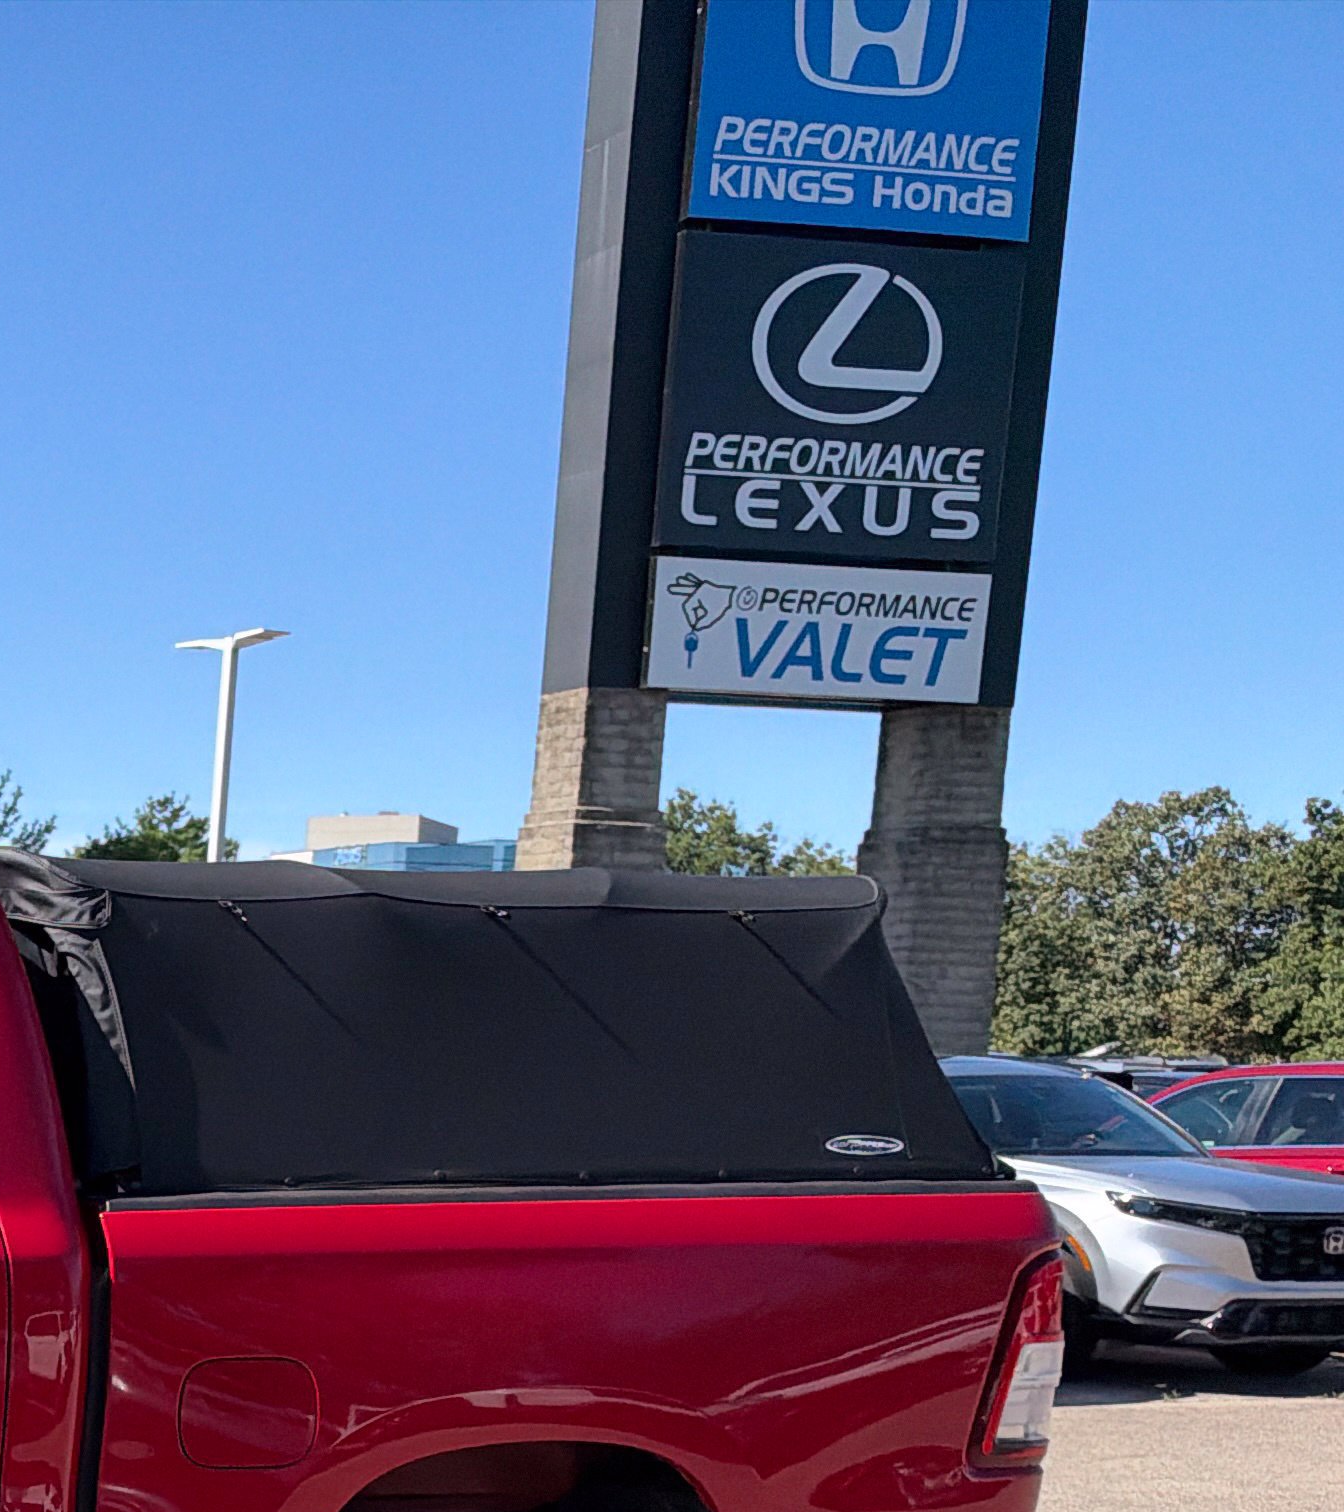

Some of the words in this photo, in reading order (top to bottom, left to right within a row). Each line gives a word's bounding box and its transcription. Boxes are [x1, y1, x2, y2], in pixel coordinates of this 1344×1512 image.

[713, 115, 1020, 174] PERFORMANCE
[709, 162, 855, 205] KINGS
[872, 174, 1013, 218] Honda
[684, 431, 985, 483] PERFORMANCE
[680, 474, 981, 540] LEXUS
[758, 587, 978, 622] PERFORMANCE
[735, 617, 969, 687] VALET
